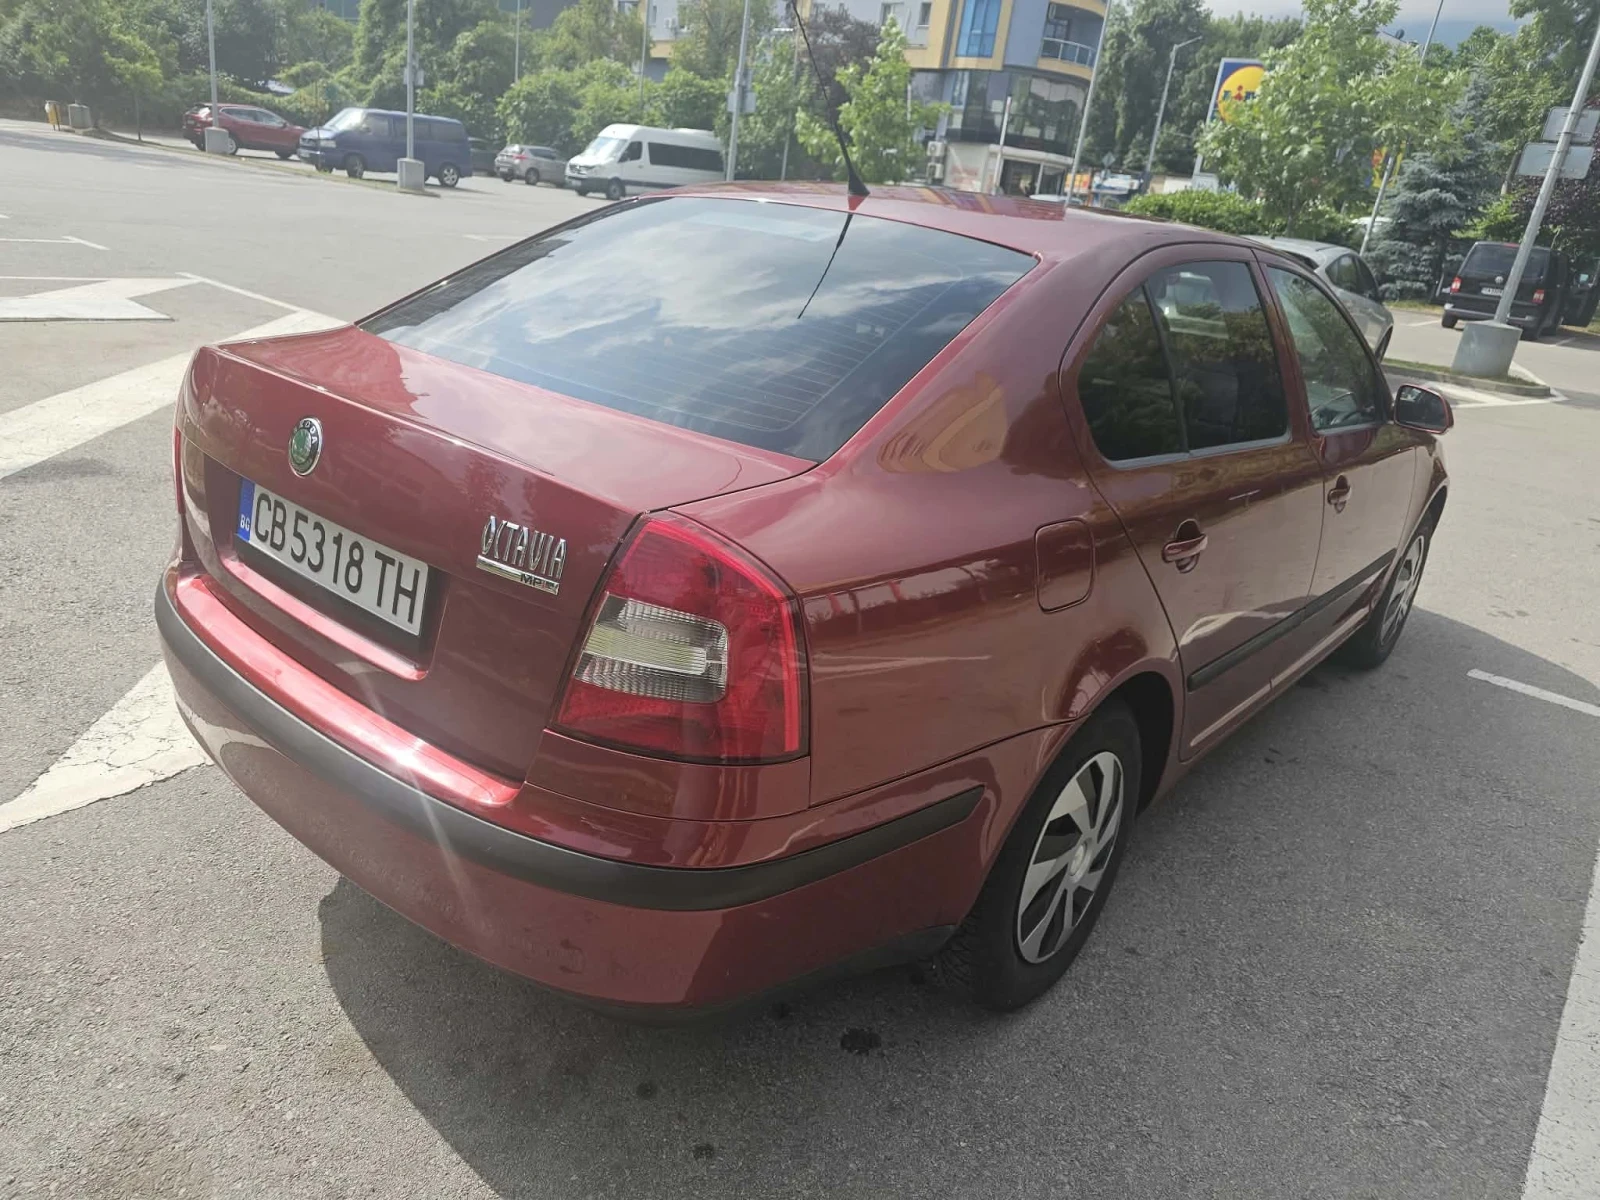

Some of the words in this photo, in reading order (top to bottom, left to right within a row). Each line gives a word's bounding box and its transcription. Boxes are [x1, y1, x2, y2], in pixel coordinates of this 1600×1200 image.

[240, 514, 251, 532] BG
[481, 515, 567, 580] OCTAVIA
[254, 492, 287, 551] CB
[290, 510, 364, 594] 5318
[374, 549, 420, 625] TH
